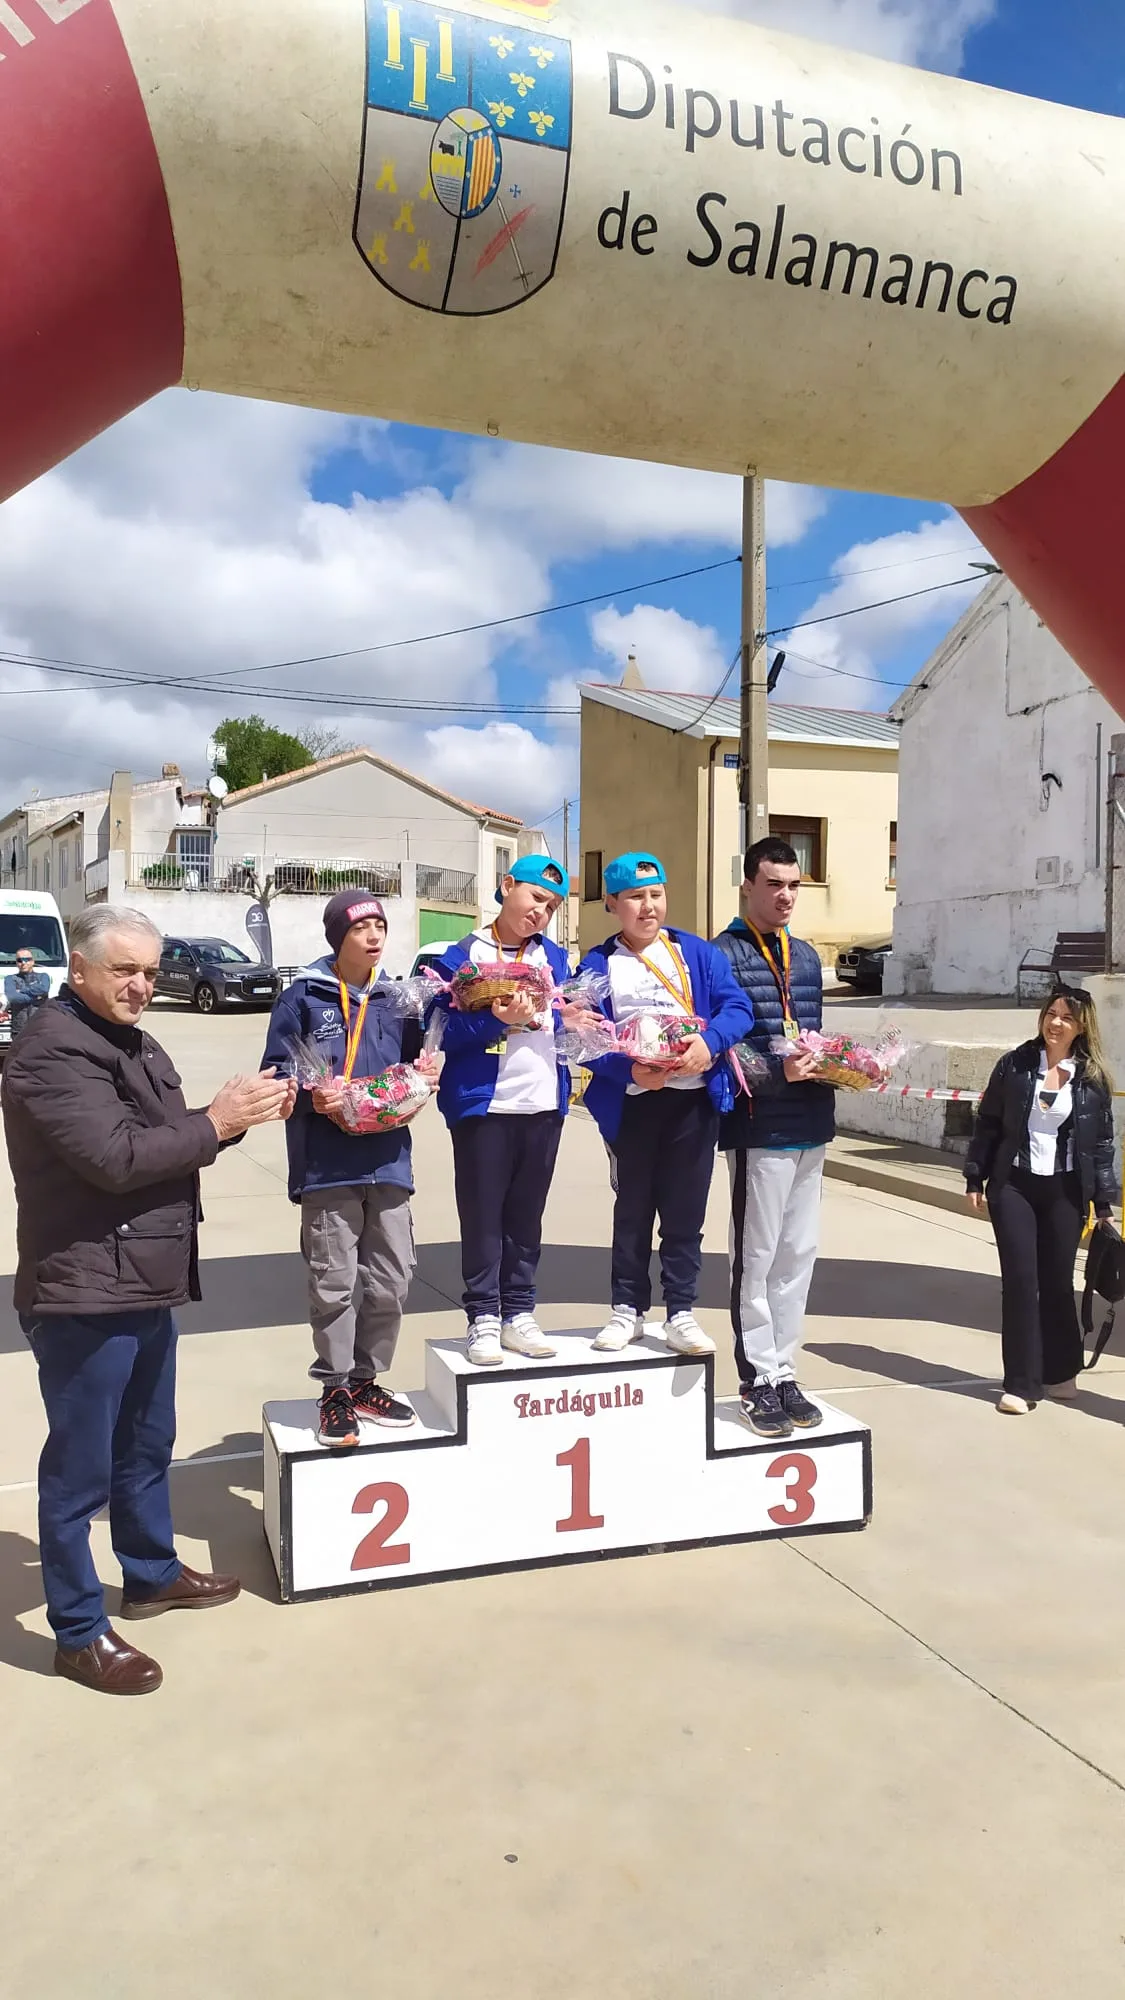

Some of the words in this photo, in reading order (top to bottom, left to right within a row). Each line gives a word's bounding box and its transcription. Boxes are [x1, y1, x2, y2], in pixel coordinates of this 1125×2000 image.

[607, 51, 963, 196] Diputación
[597, 190, 658, 256] de
[686, 192, 1018, 326] Salamanca
[349, 902, 380, 918] MARVEL
[169, 972, 190, 981] EBRO
[513, 1382, 644, 1418] Tardáguila
[555, 1437, 605, 1532] 1
[765, 1453, 818, 1525] 3
[350, 1481, 411, 1571] 2
